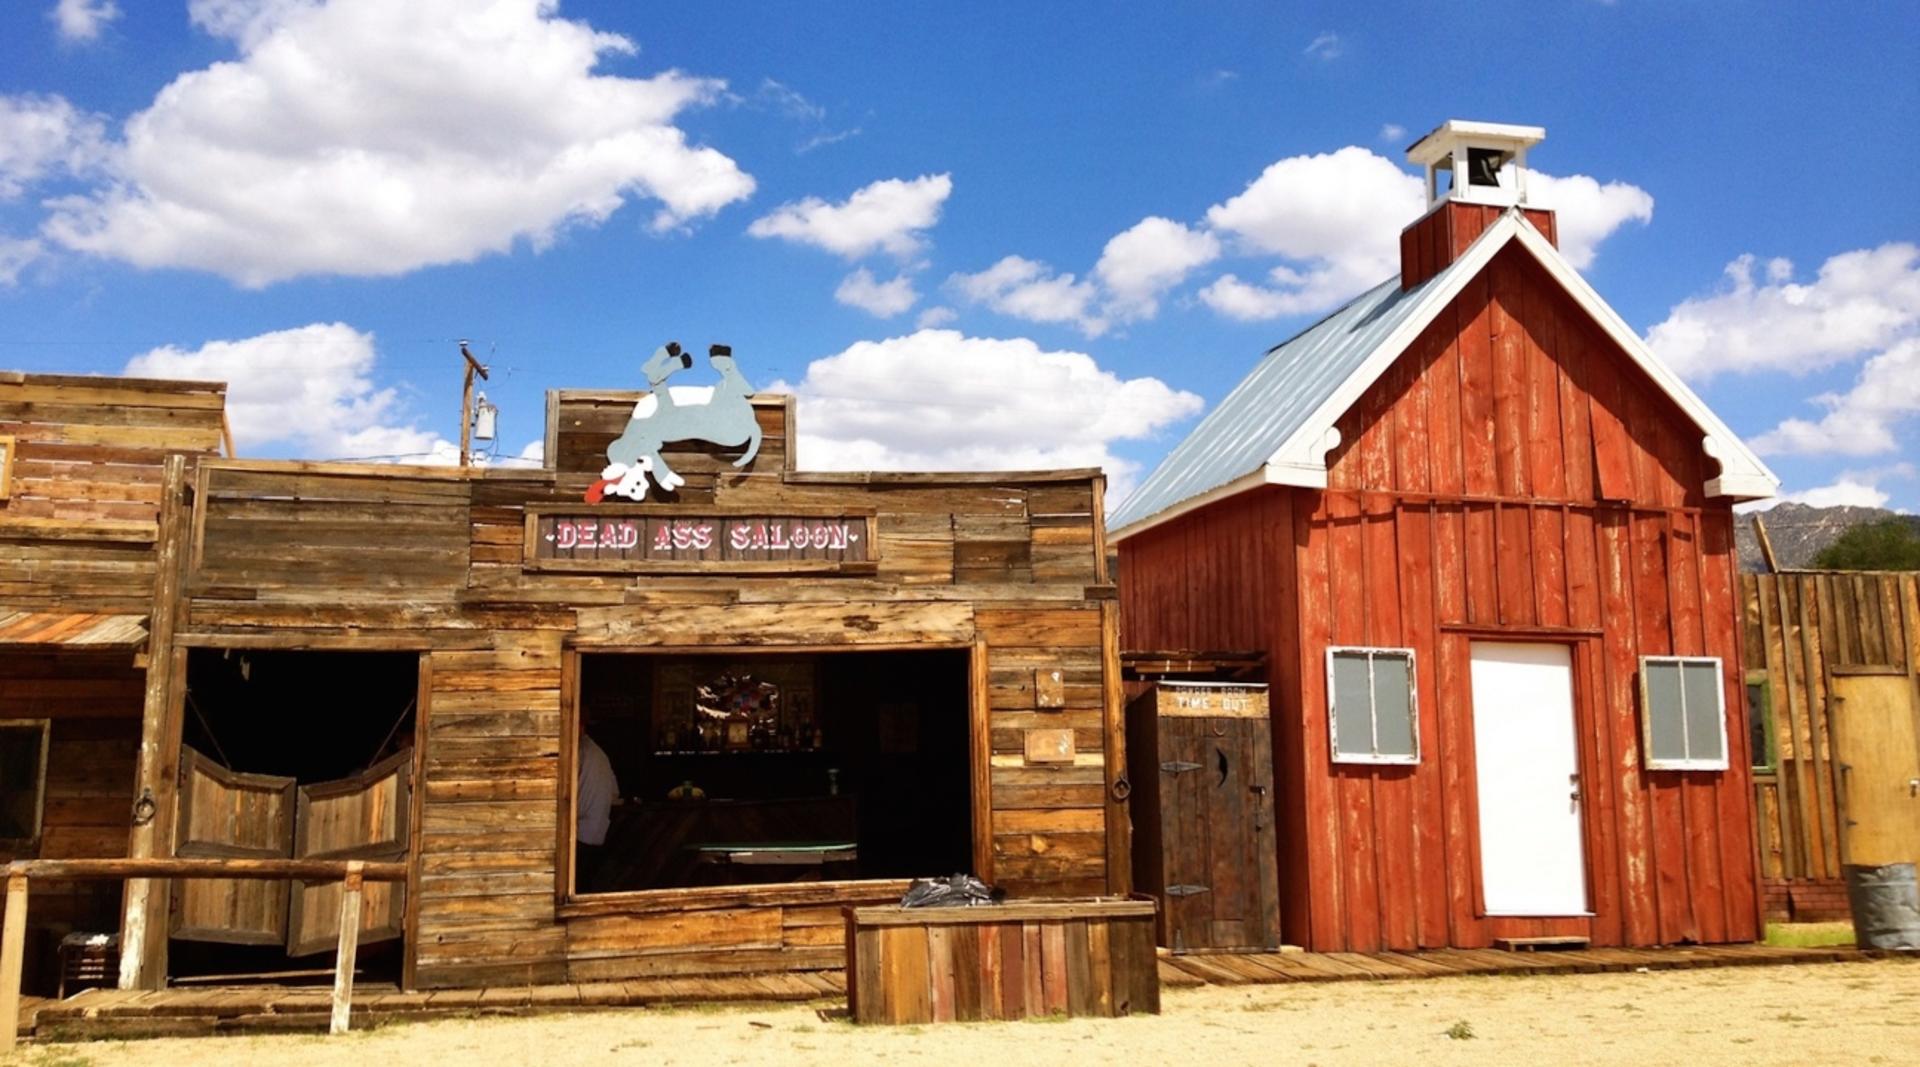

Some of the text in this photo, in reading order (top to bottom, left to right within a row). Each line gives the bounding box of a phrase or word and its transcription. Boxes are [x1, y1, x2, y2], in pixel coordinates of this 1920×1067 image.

[557, 523, 848, 550] DEAD ASS SALOON
[1177, 697, 1249, 711] TIME OUT
